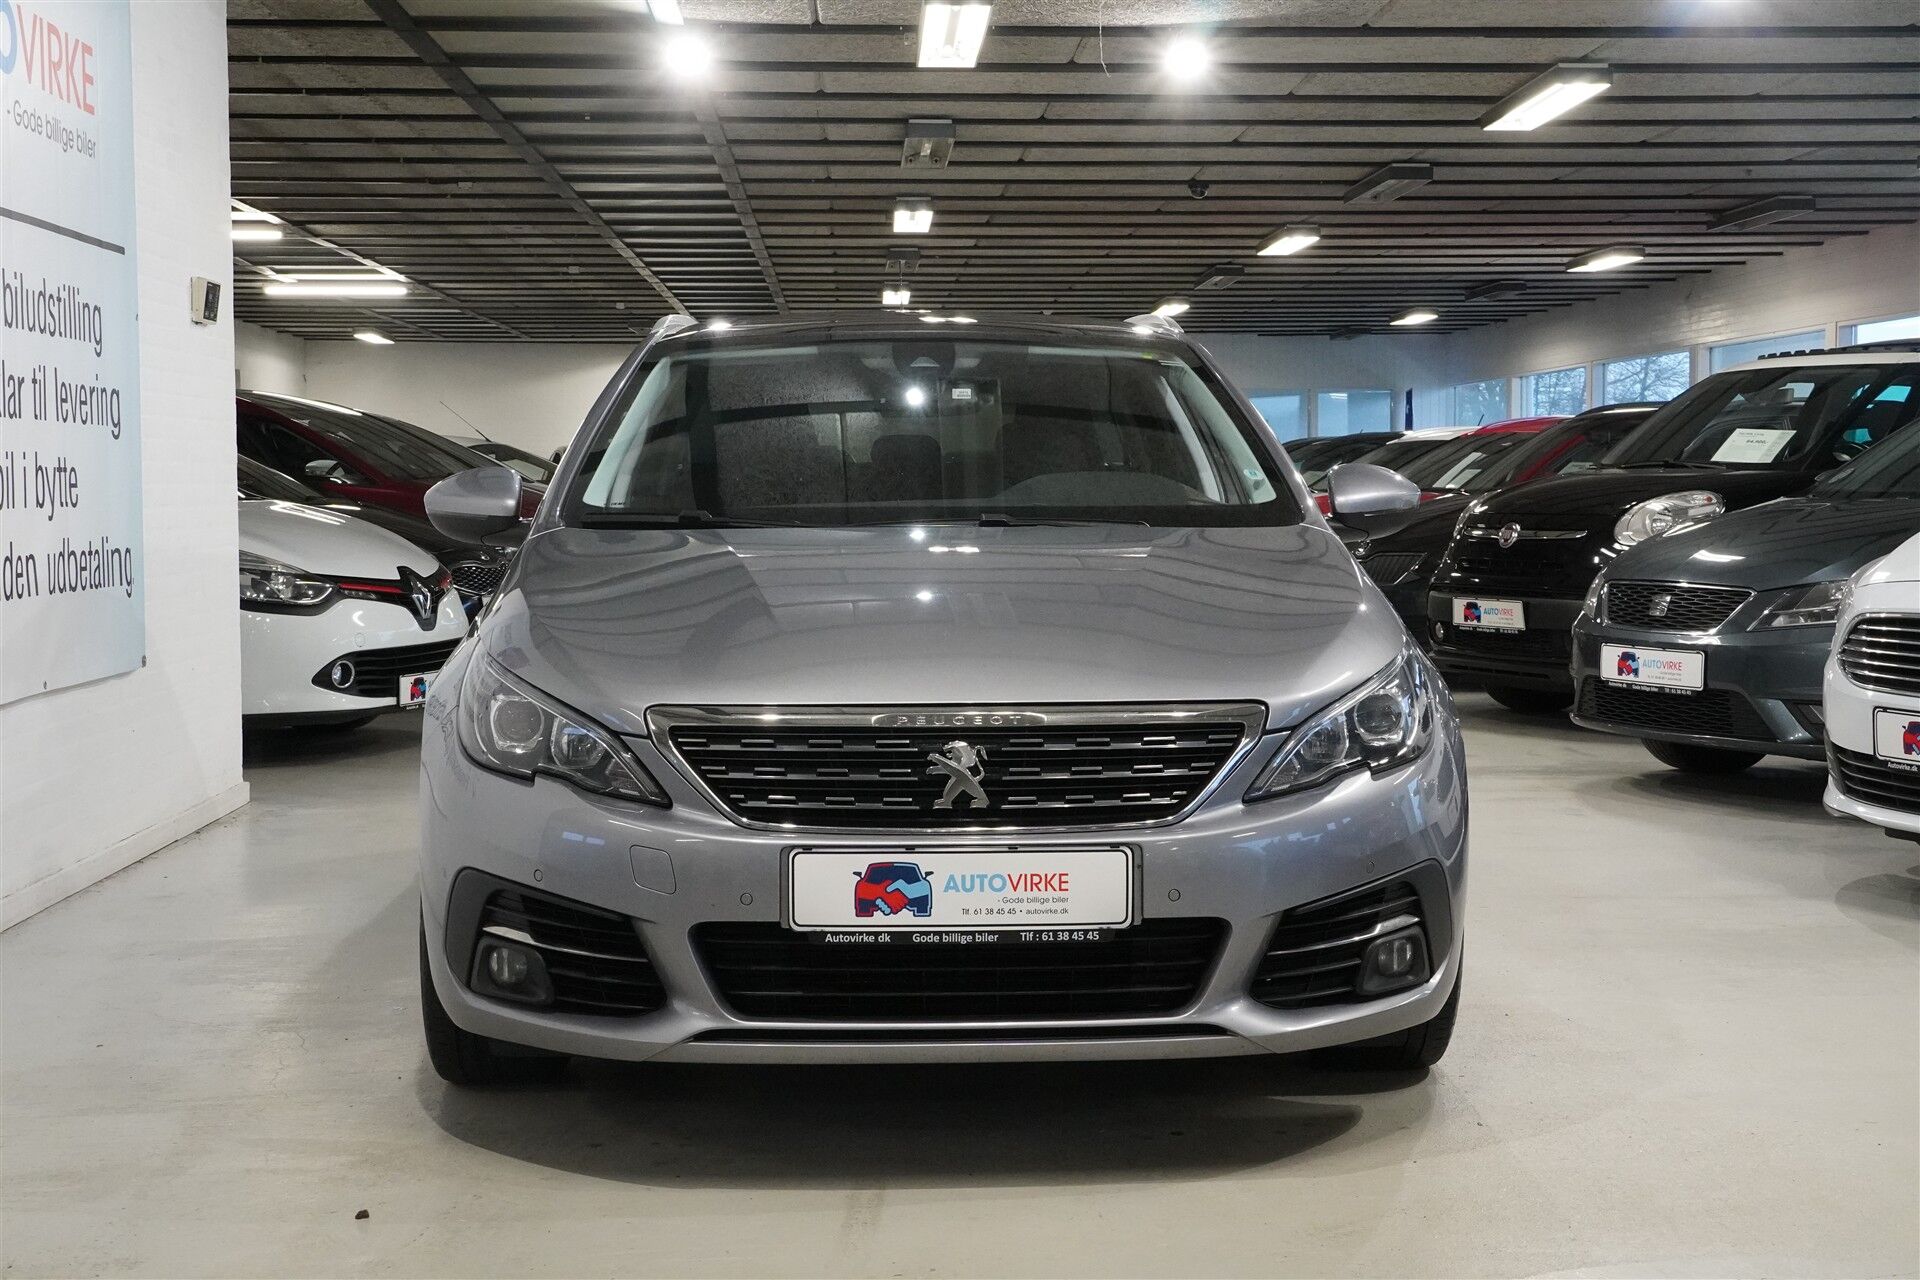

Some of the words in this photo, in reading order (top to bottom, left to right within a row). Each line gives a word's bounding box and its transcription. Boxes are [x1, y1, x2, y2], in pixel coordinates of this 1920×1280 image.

[13, 100, 43, 136] Gode
[45, 114, 75, 153] billige
[76, 128, 96, 159] biler
[2, 268, 103, 358] biludstilling
[0, 359, 25, 419] lar
[31, 364, 47, 421] til
[54, 367, 121, 440] levering
[22, 451, 28, 509] i
[34, 451, 79, 522] bytte
[3, 541, 39, 601] den
[1643, 659, 1683, 671] AUTOVIRKE
[897, 715, 1022, 725] PEUGEOT
[943, 873, 1069, 893] AUTOVIRKE
[1002, 896, 1025, 904] Gode
[1026, 896, 1050, 905] billige
[1051, 895, 1069, 904] biler
[1025, 907, 1069, 915] autovirke.dk
[825, 933, 875, 943] Autovirke
[878, 933, 891, 943] dk
[912, 933, 940, 943] Gode
[942, 932, 973, 944] billige
[975, 932, 999, 942] biler
[1041, 931, 1054, 941] 61
[1057, 931, 1070, 941] 38
[1071, 931, 1084, 940] 45
[1086, 931, 1099, 940] 45
